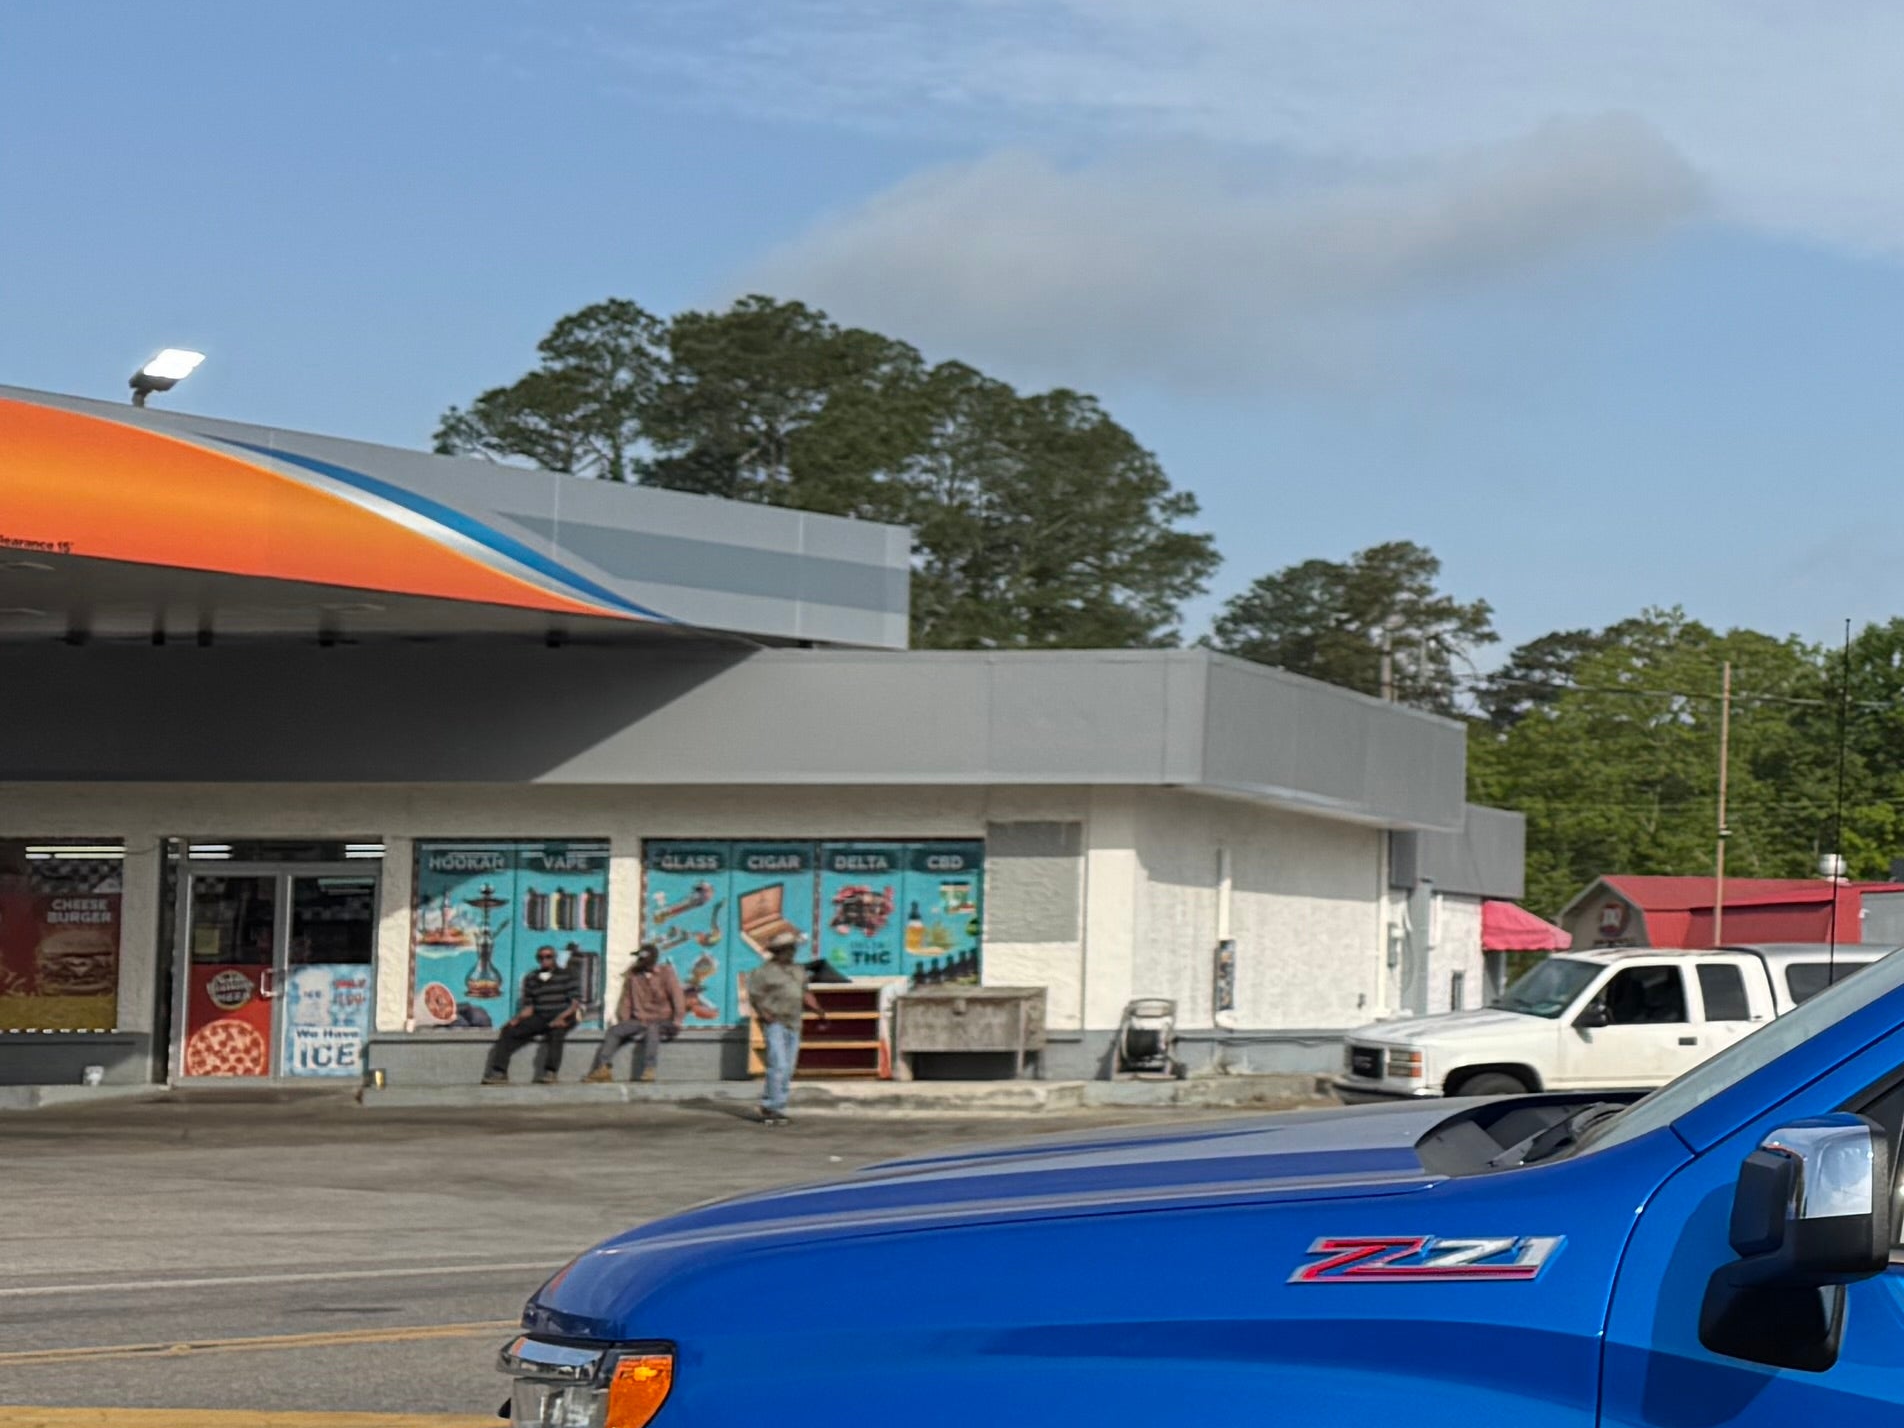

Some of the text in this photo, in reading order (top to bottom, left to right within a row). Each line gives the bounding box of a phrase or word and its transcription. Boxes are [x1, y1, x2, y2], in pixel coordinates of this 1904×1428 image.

[0, 534, 54, 550] learance
[428, 855, 505, 870] HOOKAH
[543, 855, 589, 869] VAPE
[661, 854, 719, 870] GLASS
[747, 854, 801, 870] CIGAR
[834, 855, 889, 870] DELTA
[927, 854, 964, 870] CBD
[51, 898, 107, 910] CHEESE
[47, 911, 112, 924] BURGER
[851, 950, 891, 965] THC
[296, 1027, 359, 1038] We Have
[300, 1042, 355, 1069] ICE
[1286, 1234, 1566, 1284] Z71
